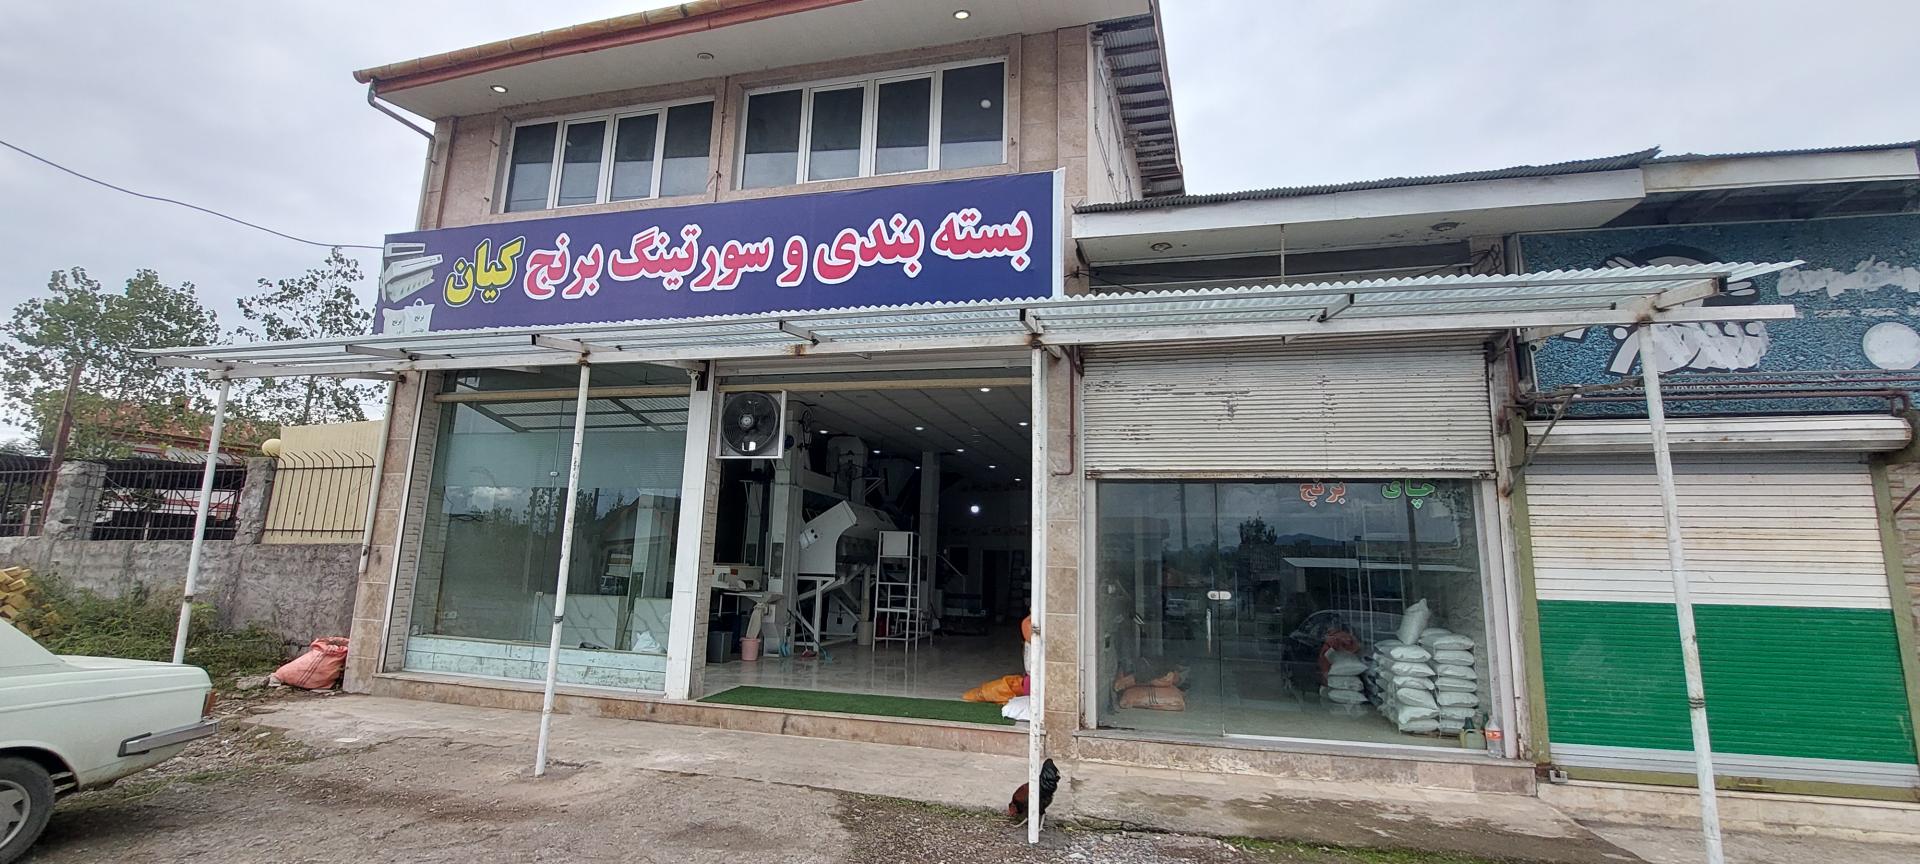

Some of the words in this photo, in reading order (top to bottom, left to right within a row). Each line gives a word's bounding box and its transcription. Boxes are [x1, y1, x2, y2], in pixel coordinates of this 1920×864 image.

[444, 236, 525, 306] کیان
[523, 233, 604, 299] برنج
[608, 224, 774, 291] سورتینگ
[776, 235, 808, 287] و
[813, 213, 925, 284] بندی
[931, 208, 1033, 271] بسته
[1300, 478, 1346, 508] برنج
[1381, 478, 1436, 510] چای
